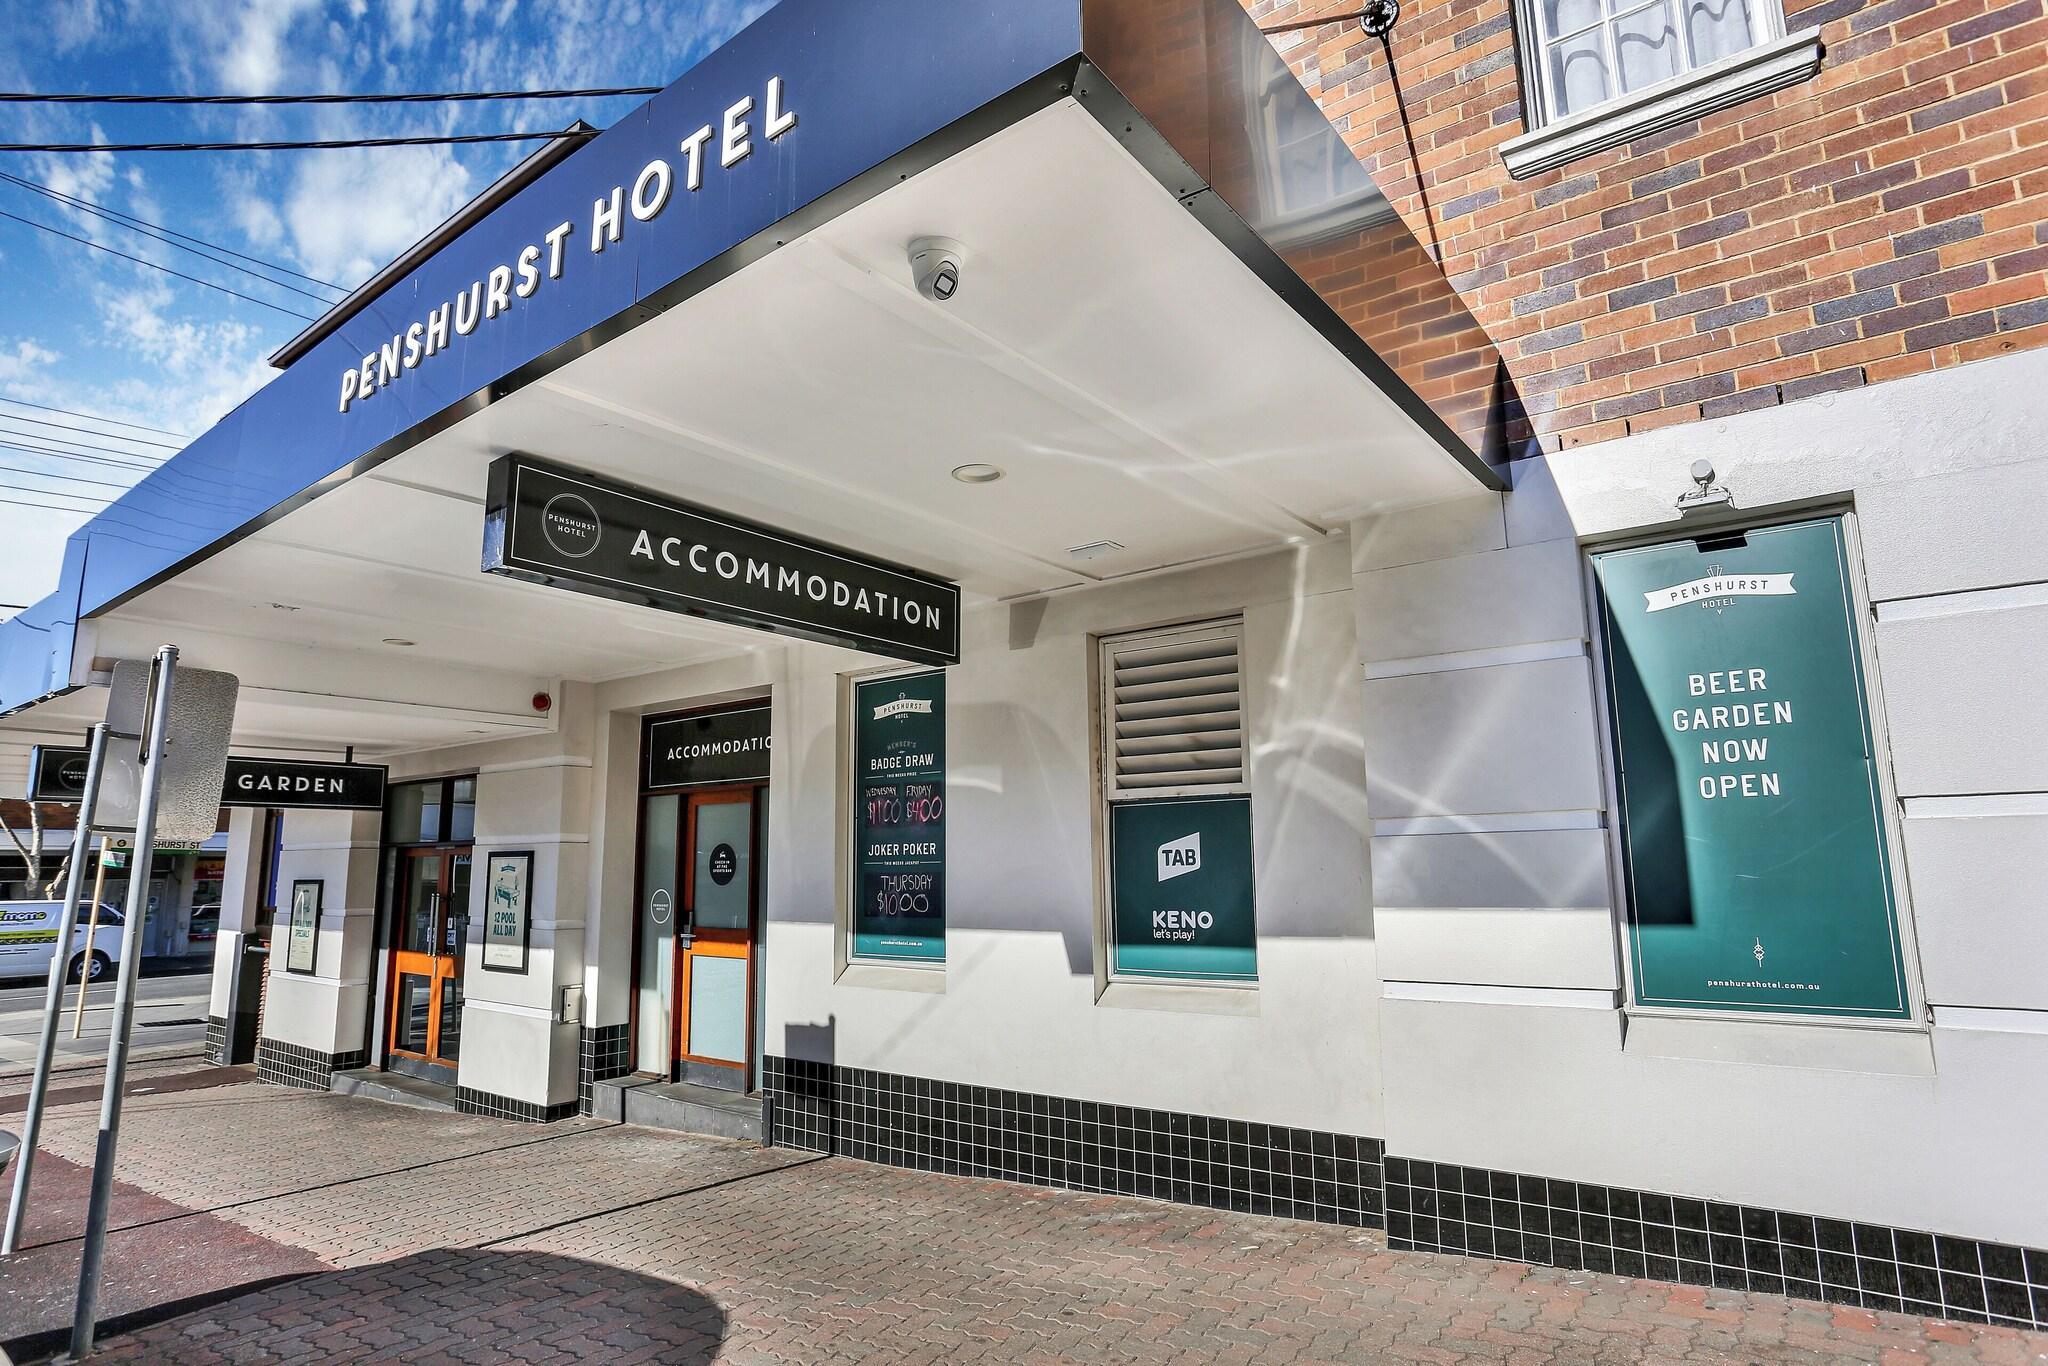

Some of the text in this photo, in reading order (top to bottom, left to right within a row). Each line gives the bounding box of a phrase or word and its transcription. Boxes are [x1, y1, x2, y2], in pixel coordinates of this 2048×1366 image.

[339, 75, 798, 413] PENSHURST HOTEL
[548, 513, 596, 532] PENSHURST
[557, 525, 586, 538] HOTEL
[630, 529, 941, 631] ACCOMMODATION
[1670, 579, 1769, 602] PENSHURST
[1701, 598, 1736, 608] HOTEL
[1688, 667, 1768, 697] BEER
[883, 702, 922, 714] PENSHURST
[1672, 700, 1794, 732] GARDEN
[667, 736, 773, 760] ACCOMMODATIO
[1702, 738, 1768, 764] NOW
[871, 753, 934, 770] BADGE DRAW
[238, 774, 344, 793] GARDEN
[906, 784, 932, 798] FRIDAY
[1699, 772, 1781, 799] OPEN
[906, 795, 943, 822] $400
[868, 843, 936, 856] JOKER POKER
[1161, 849, 1197, 866] TAB
[880, 874, 933, 892] THURSDAY
[877, 890, 929, 915] $1000
[501, 912, 516, 924] POOL
[1152, 910, 1214, 929] KENO
[493, 924, 517, 937] ALL DAY
[1153, 929, 1195, 941] let's play!
[1707, 979, 1820, 990] penshursthotel.com.au
